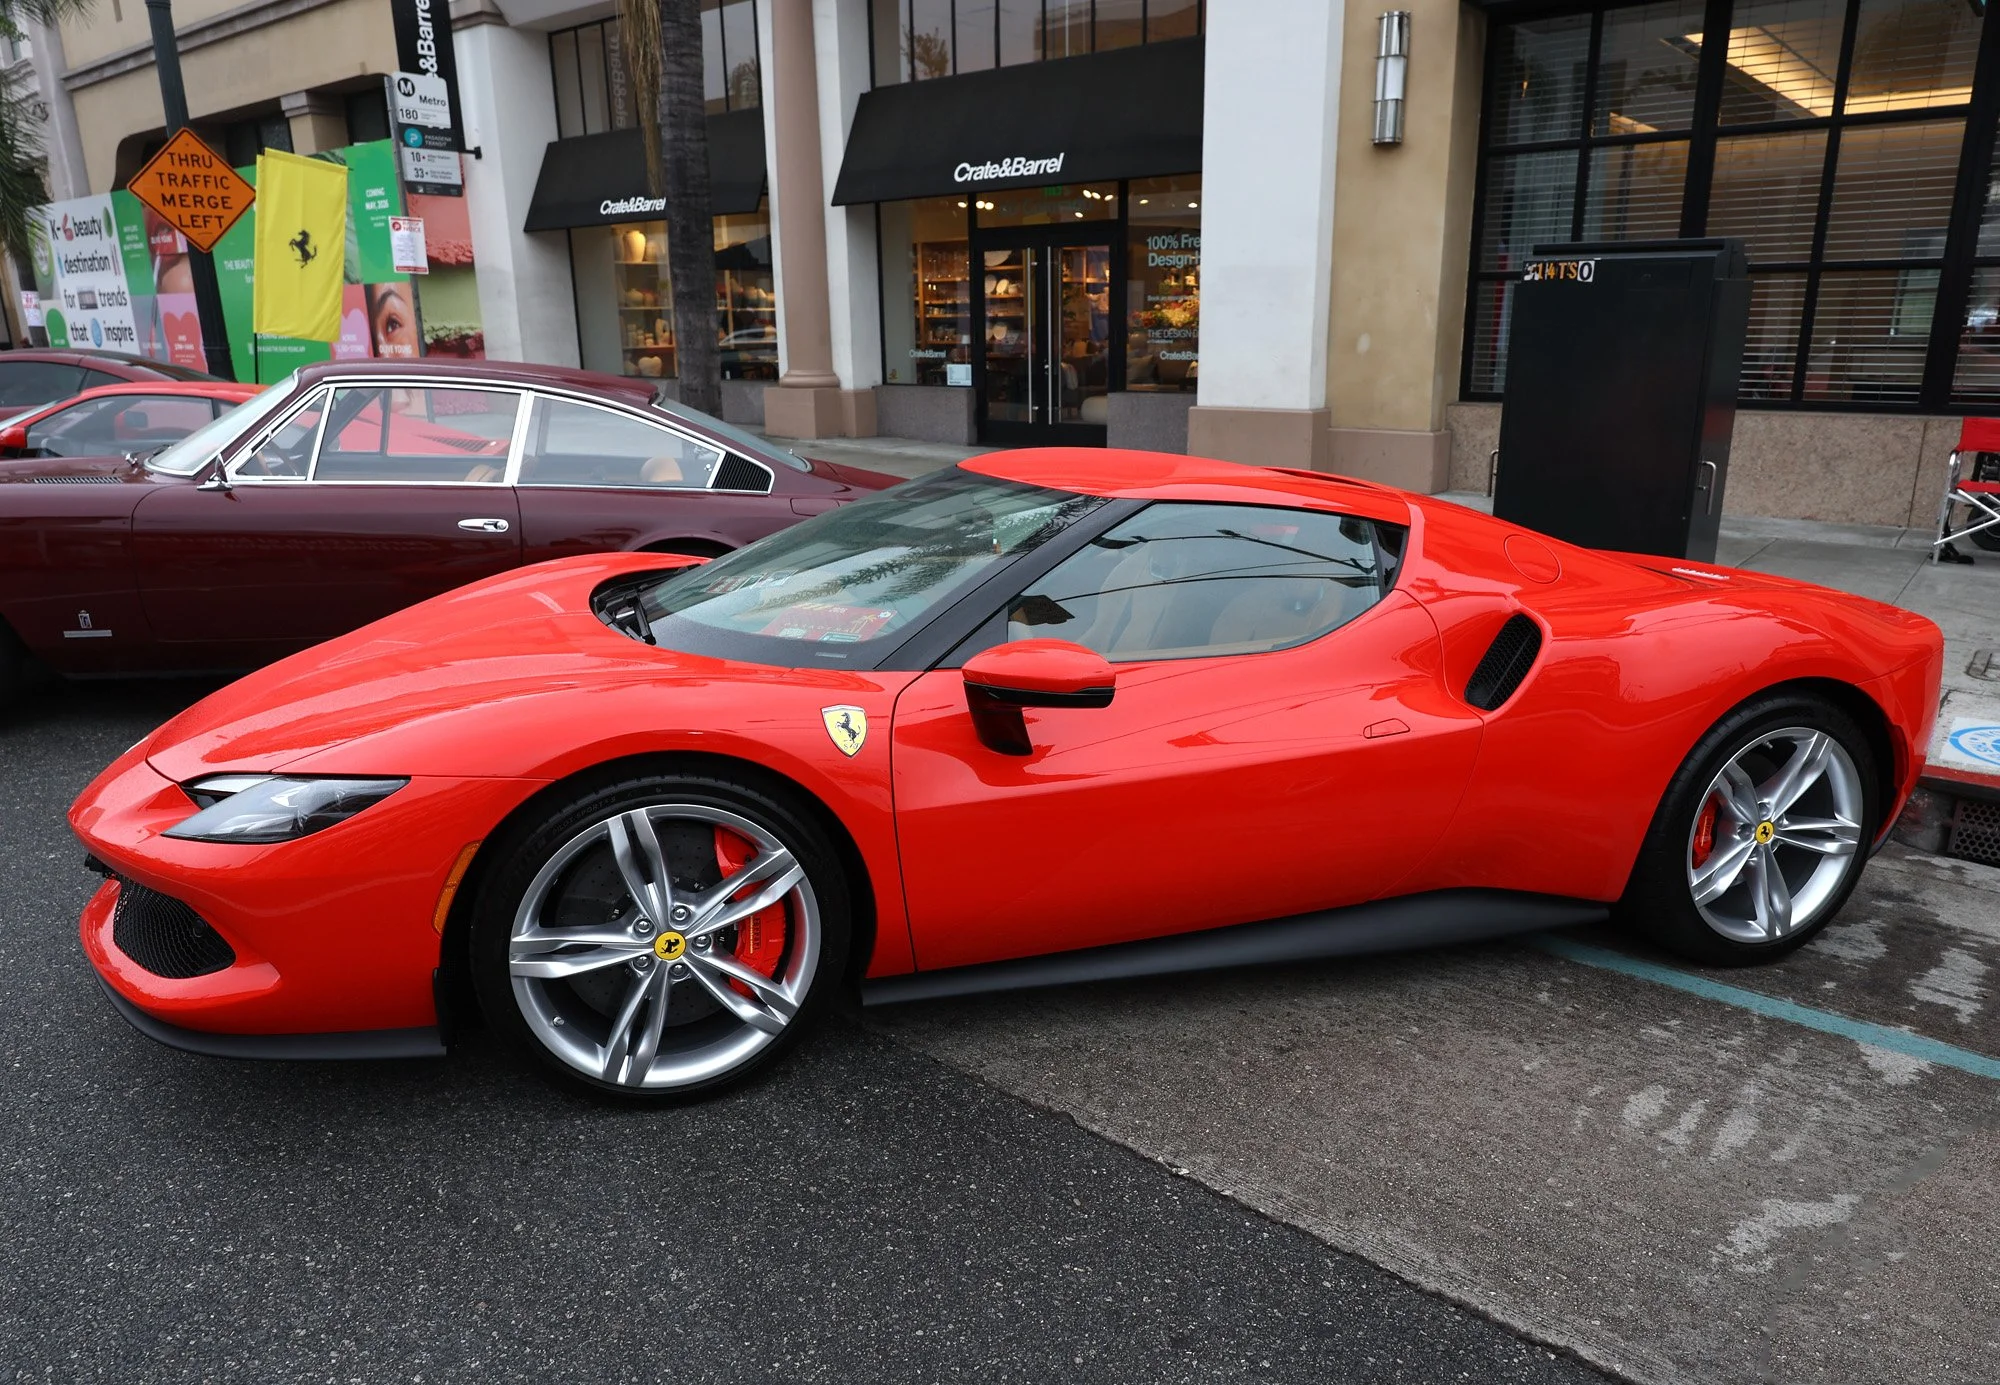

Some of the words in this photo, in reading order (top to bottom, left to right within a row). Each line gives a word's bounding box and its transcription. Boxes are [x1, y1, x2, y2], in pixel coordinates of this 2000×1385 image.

[415, 0, 438, 73] &Barre
[400, 80, 414, 95] M
[419, 95, 446, 107] Metro
[400, 108, 418, 120] 180
[168, 152, 213, 169] THRU
[411, 151, 421, 163] 10
[414, 167, 425, 179] 33
[954, 152, 1065, 182] Crate&Barrel
[156, 172, 231, 190] TRAFFIC
[161, 193, 233, 209] MERGE
[600, 196, 667, 215] Crate&Barrel
[50, 219, 61, 240] K-
[72, 216, 102, 240] beauty
[178, 214, 225, 229] LEFT
[1147, 235, 1179, 250] 100%
[1181, 234, 1201, 248] Fre
[64, 250, 111, 274] destination
[1148, 252, 1193, 269] Design
[64, 289, 76, 309] for
[98, 286, 128, 307] trends
[70, 322, 89, 342] that
[103, 320, 134, 347] inspire
[1148, 329, 1163, 338] THE
[1164, 329, 1191, 338] DESIGN
[909, 349, 947, 358] Crate&Barrel
